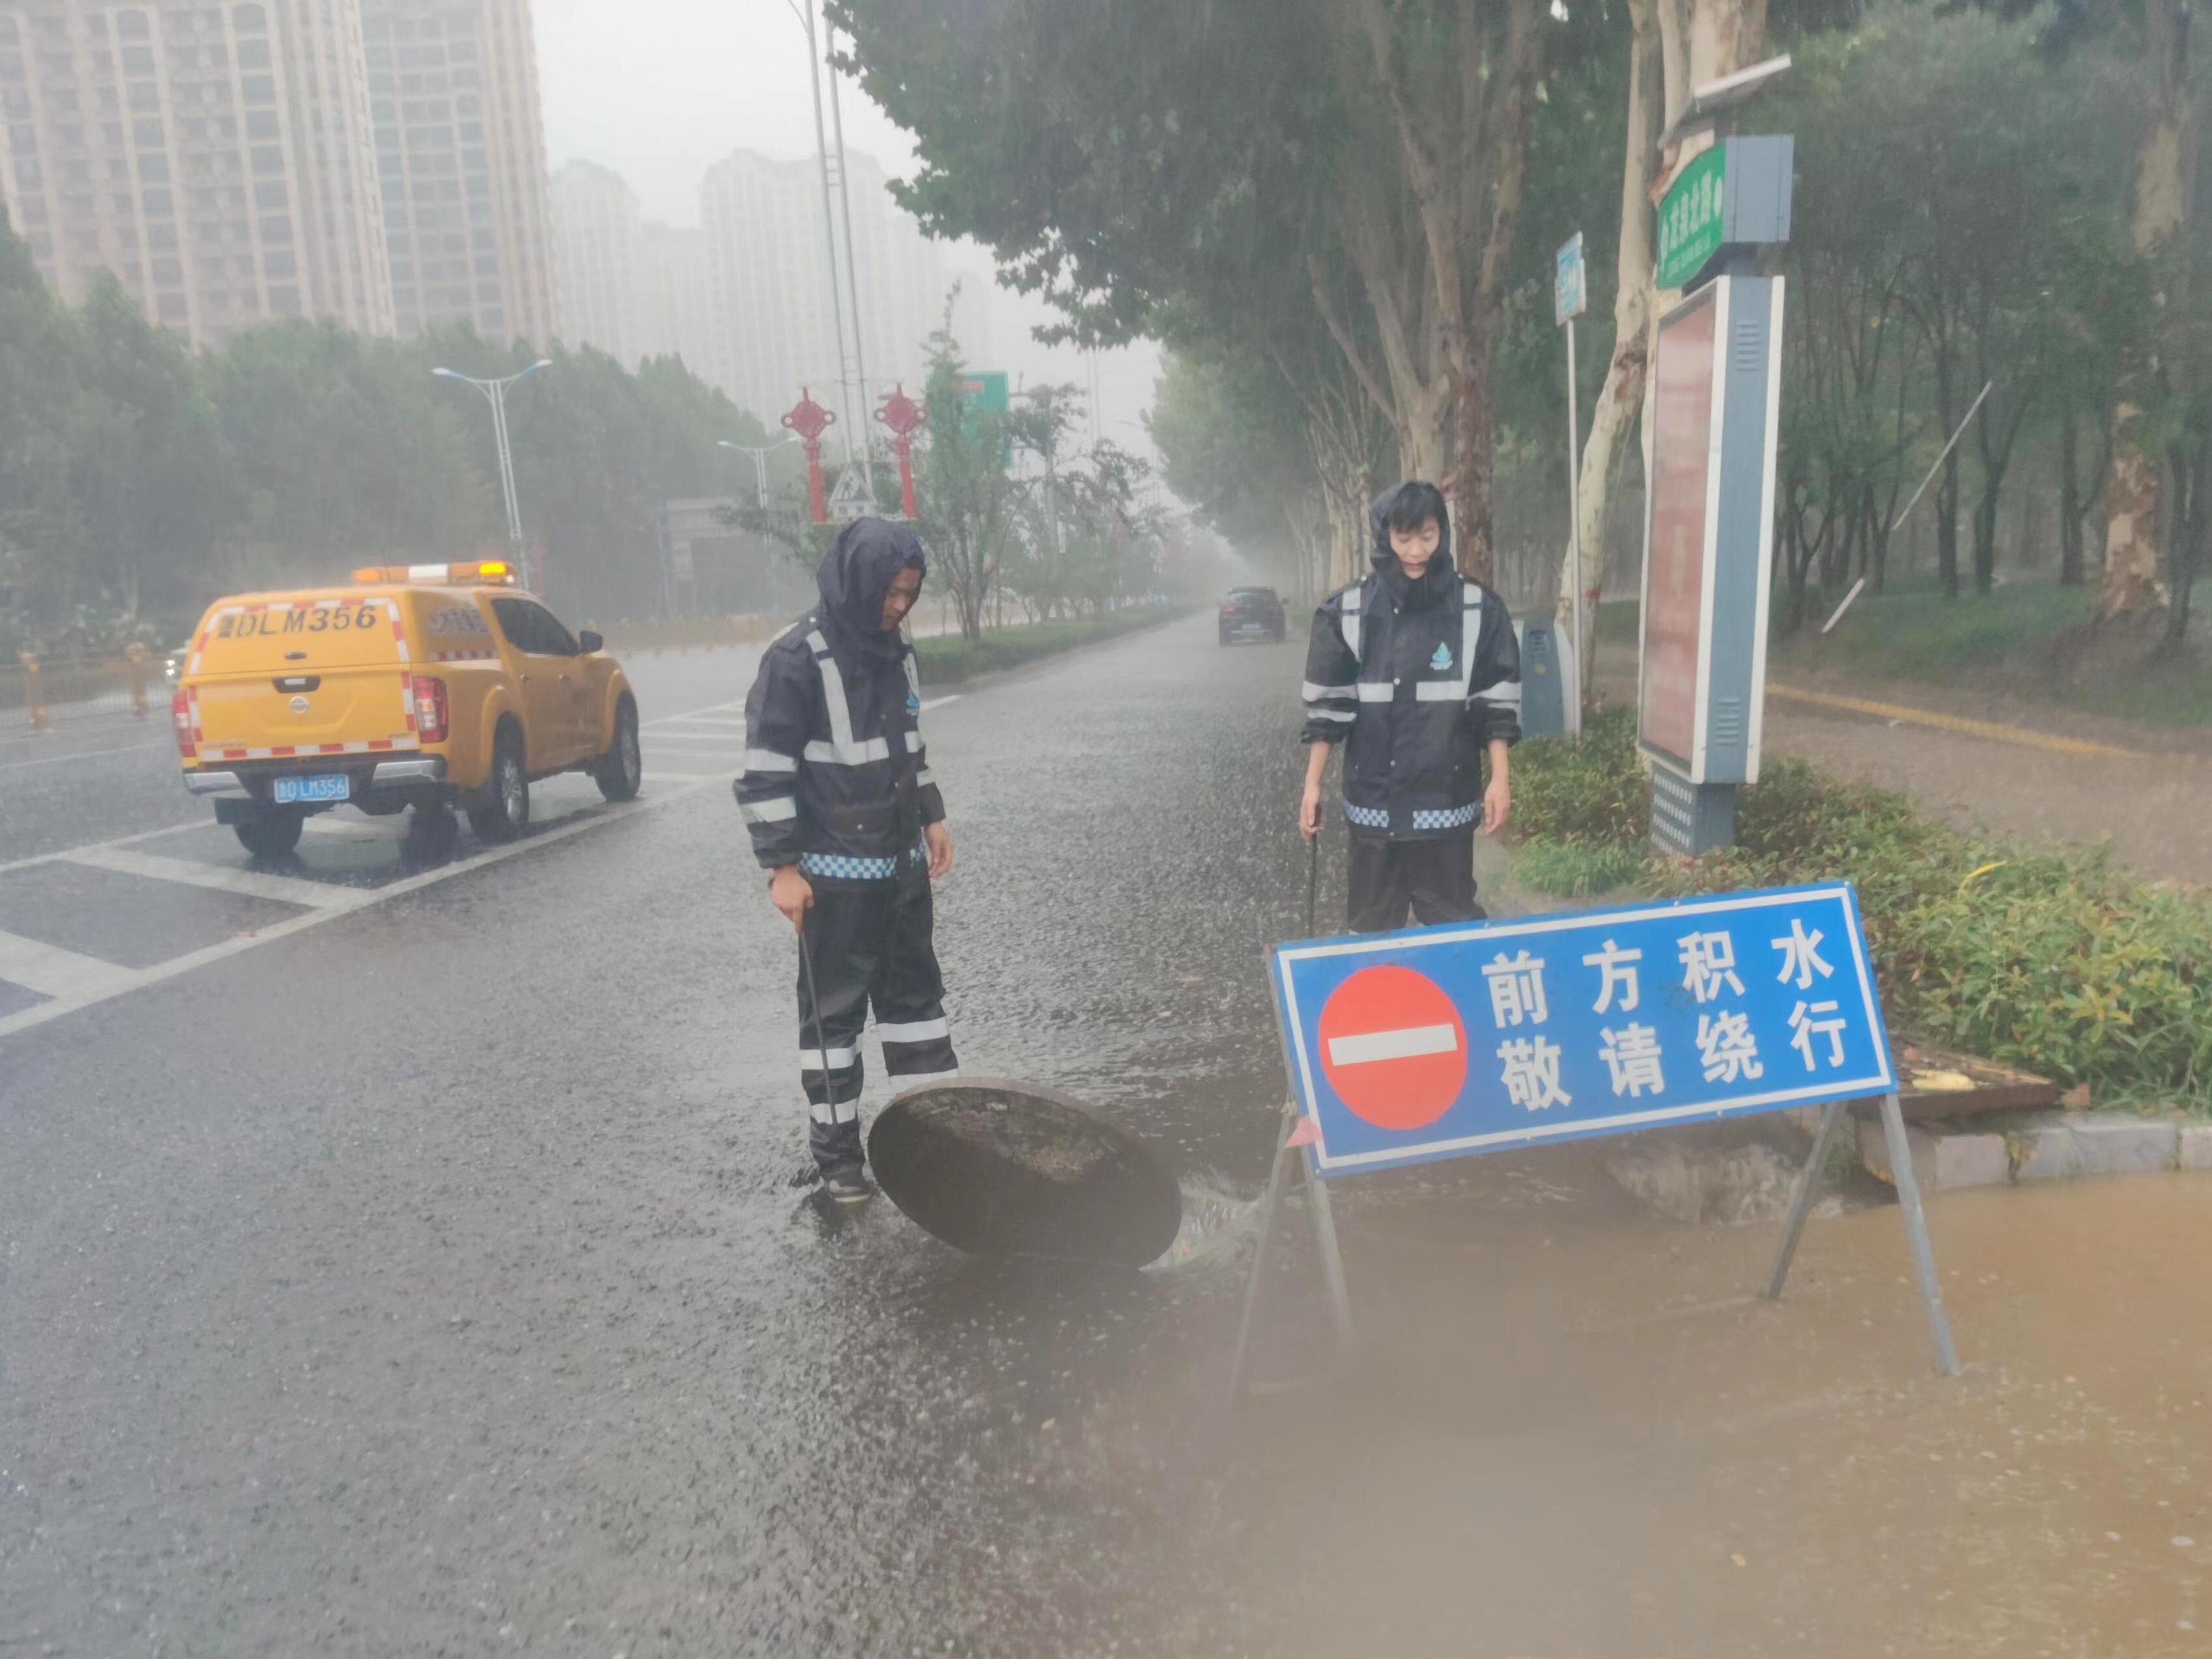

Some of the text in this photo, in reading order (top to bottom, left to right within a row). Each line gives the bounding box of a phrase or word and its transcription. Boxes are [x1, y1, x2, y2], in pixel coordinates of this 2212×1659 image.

[1481, 918, 1835, 1029] 前方积水
[1496, 999, 1846, 1112] 敬请绕行
